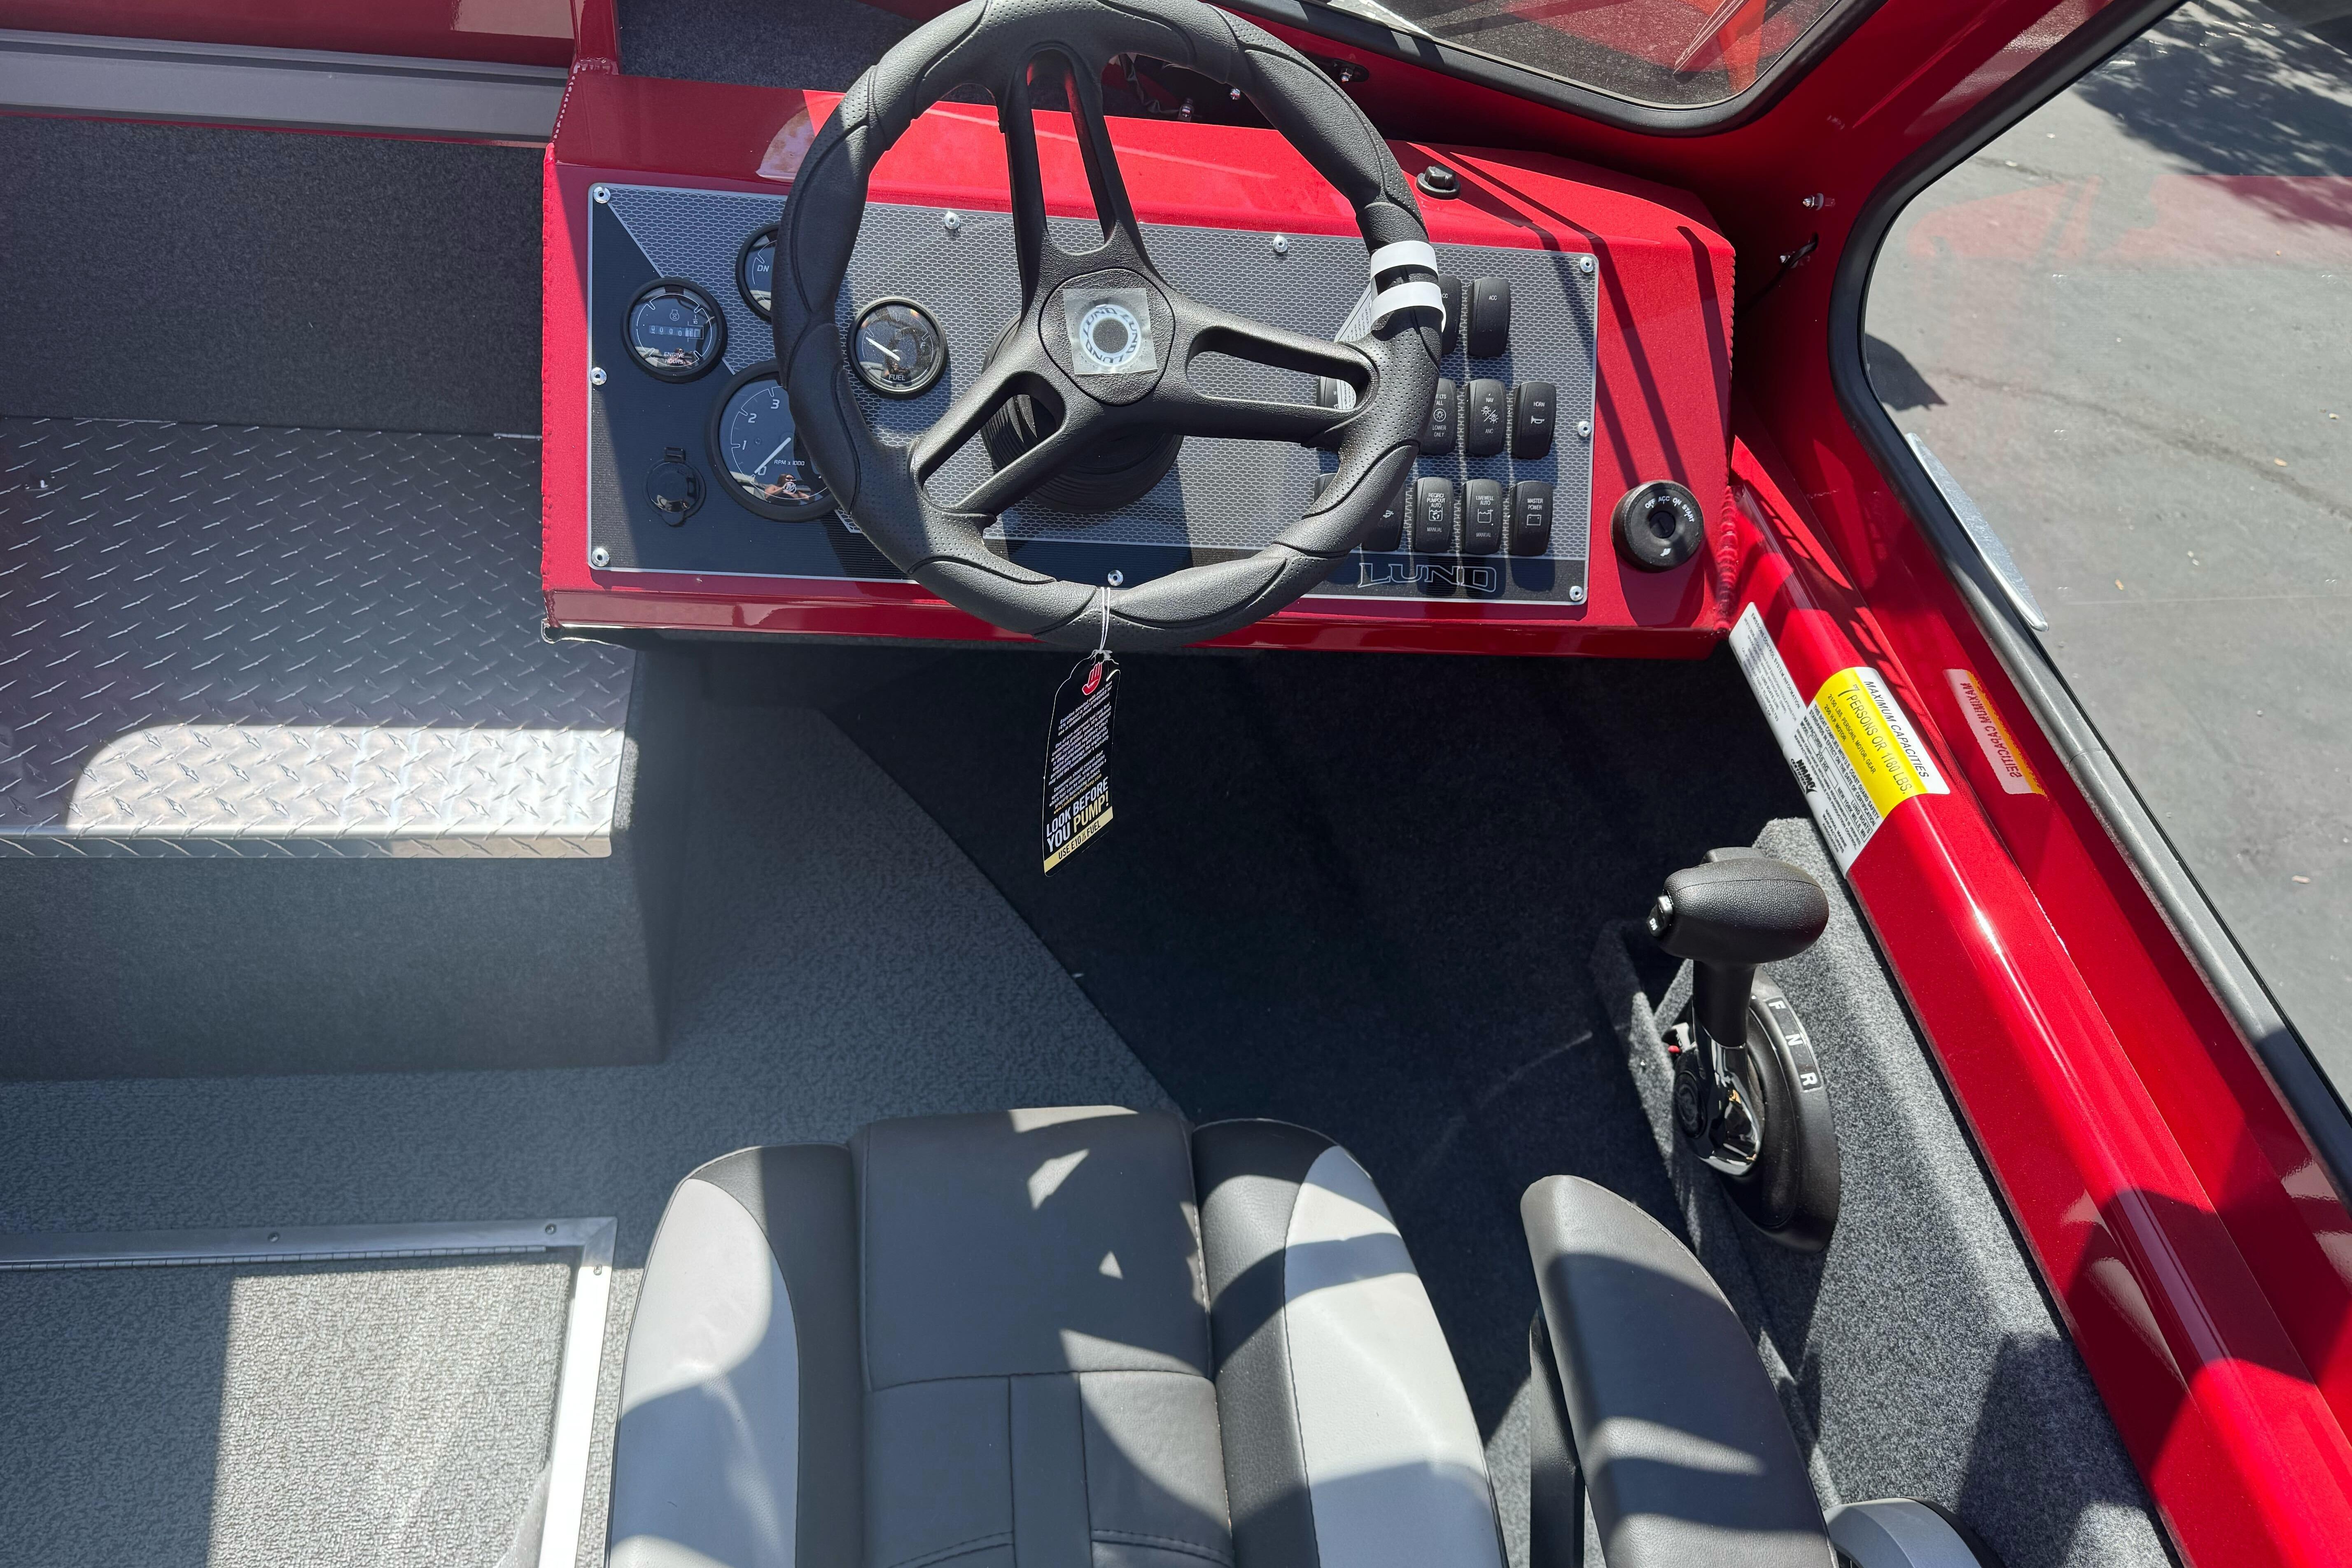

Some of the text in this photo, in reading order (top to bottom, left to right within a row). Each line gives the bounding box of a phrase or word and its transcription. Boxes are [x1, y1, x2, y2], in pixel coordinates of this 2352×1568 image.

[748, 413, 757, 423] 2
[770, 399, 780, 409] 3
[742, 440, 747, 450] 1
[1645, 498, 1656, 509] OFF
[1682, 504, 1694, 522] START
[1358, 562, 1497, 593] LUND
[1751, 613, 1800, 709] EMISSIONS CONTROL SYSTEM INFORMATION
[1828, 694, 1837, 707] 2150
[1841, 717, 1856, 742] PERSONS,
[1855, 740, 1867, 761] MOTOR,
[1866, 759, 1876, 774] GEAR
[1835, 723, 1846, 742] MOTOR
[1838, 684, 1912, 794] 7 PERSONS OR 1180 LBS.
[1864, 682, 1929, 777] MAXIMUM CAPACITIES
[1791, 759, 1806, 784] CERTIFIED
[1809, 709, 1824, 735] STANDARDS
[1826, 740, 1836, 759] EFFECT
[1855, 792, 1876, 826] CERTIFICATION
[1816, 751, 1824, 762] 210
[1826, 726, 1839, 749] COMPLIES
[1850, 769, 1860, 784] COAST
[1859, 784, 1869, 802] GUARD
[1868, 801, 1879, 819] SAFETY
[1047, 806, 1071, 838] LOOK
[1073, 776, 1108, 816] BEFORE
[1047, 821, 1071, 853] YOU
[1073, 790, 1109, 833] PUMP!
[1844, 798, 1853, 813] YORK
[1852, 813, 1861, 831] MILLS,
[1861, 829, 1866, 838] MN
[1851, 800, 1860, 815] LUND
[1859, 814, 1870, 833] BOATS
[1058, 843, 1071, 859] USE
[1071, 836, 1081, 850] E10
[1087, 820, 1101, 837] FUEL
[1769, 1000, 1786, 1009] F
[1785, 1033, 1803, 1046] N
[1800, 1072, 1818, 1086] R
